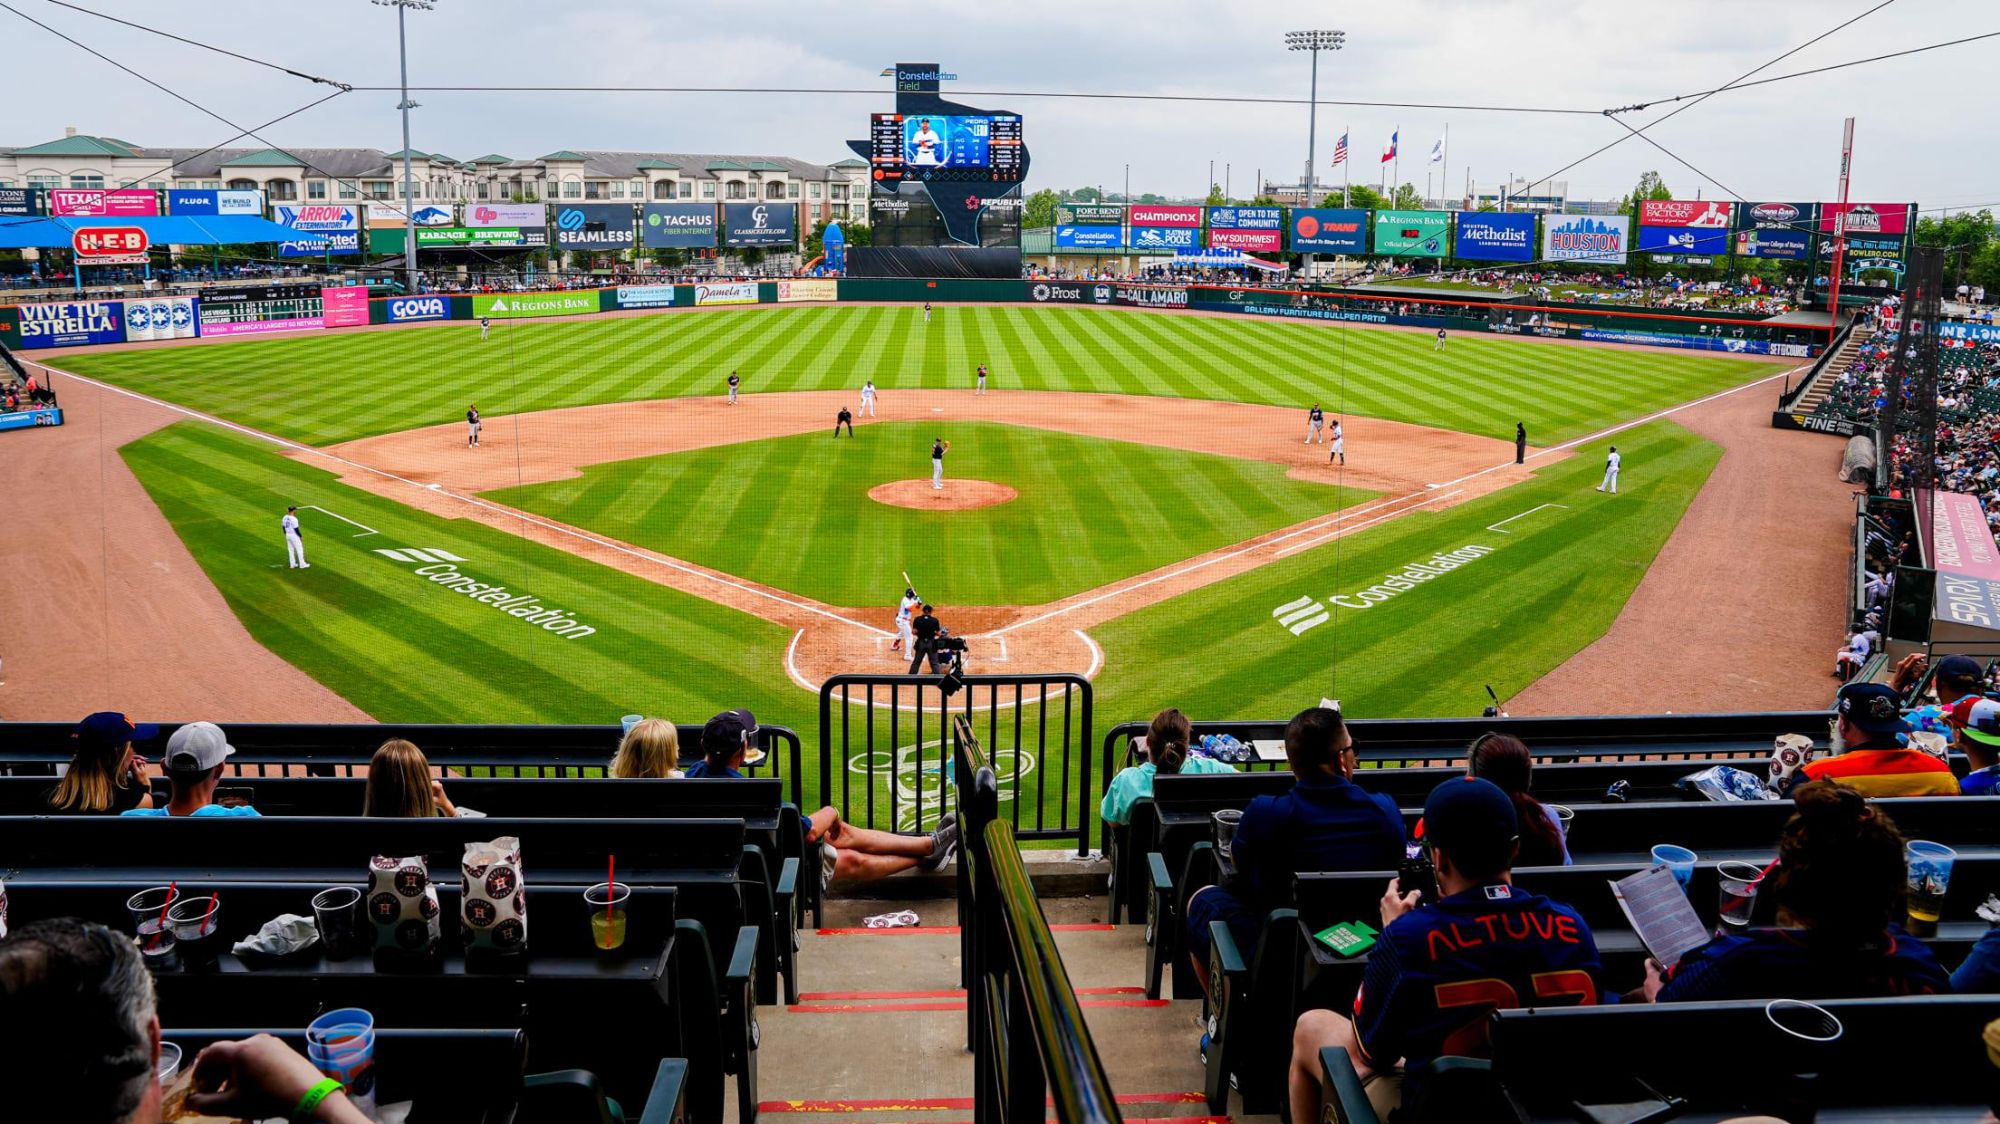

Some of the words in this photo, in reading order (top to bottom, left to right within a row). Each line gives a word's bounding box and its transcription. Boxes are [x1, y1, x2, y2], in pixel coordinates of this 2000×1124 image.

[899, 71, 957, 80] Constellation
[899, 82, 920, 91] Field
[58, 193, 102, 206] TEXAS
[980, 198, 1024, 206] REPUBLIC
[1076, 207, 1097, 215] FORT
[1099, 207, 1121, 215] BEND
[1646, 202, 1693, 210] KOLACHE
[297, 207, 343, 221] ARROW
[1238, 209, 1257, 218] OPEN
[1257, 210, 1266, 218] TO
[1267, 210, 1280, 218] THE
[1646, 210, 1690, 218] FACTORY
[663, 215, 712, 226] TACHUS
[1238, 219, 1280, 228] COMMUNITY
[1390, 216, 1423, 224] REGIONS
[1424, 217, 1445, 225] BANK
[1860, 213, 1879, 226] PEAKS
[295, 222, 344, 230] EXTERMINATORS
[1323, 223, 1358, 232] TRANE
[474, 231, 519, 239] BREWING
[559, 231, 634, 243] SEAMLESS
[1166, 235, 1192, 244] POOLS
[1229, 234, 1276, 244] SOUTHWEST
[1462, 228, 1526, 242] Methodist
[1678, 232, 1695, 243] slb
[1551, 233, 1621, 250] HOUSTON
[1551, 250, 1577, 258] TENTS
[1849, 249, 1899, 258] BOWLERO.COM
[696, 286, 740, 304] Pamela
[1051, 286, 1080, 299] Frost
[1127, 289, 1148, 302] CALL
[1150, 291, 1188, 304] AMARO
[77, 302, 100, 318] TU
[392, 298, 444, 318] GOYA
[511, 300, 562, 312] REGIONS
[564, 298, 589, 309] BANK
[1244, 305, 1278, 314] GALLERY
[1279, 307, 1323, 318] FURNITURE
[1323, 310, 1361, 321] BULLPEN
[1361, 314, 1386, 323] PATIO
[1802, 416, 1837, 432] FINE
[1329, 544, 1495, 609] Constellation
[414, 563, 597, 640] Constellation
[405, 875, 417, 887] H
[496, 879, 507, 890] H
[380, 904, 390, 915] H
[474, 908, 485, 919] H
[1427, 911, 1580, 961] ALTUVE
